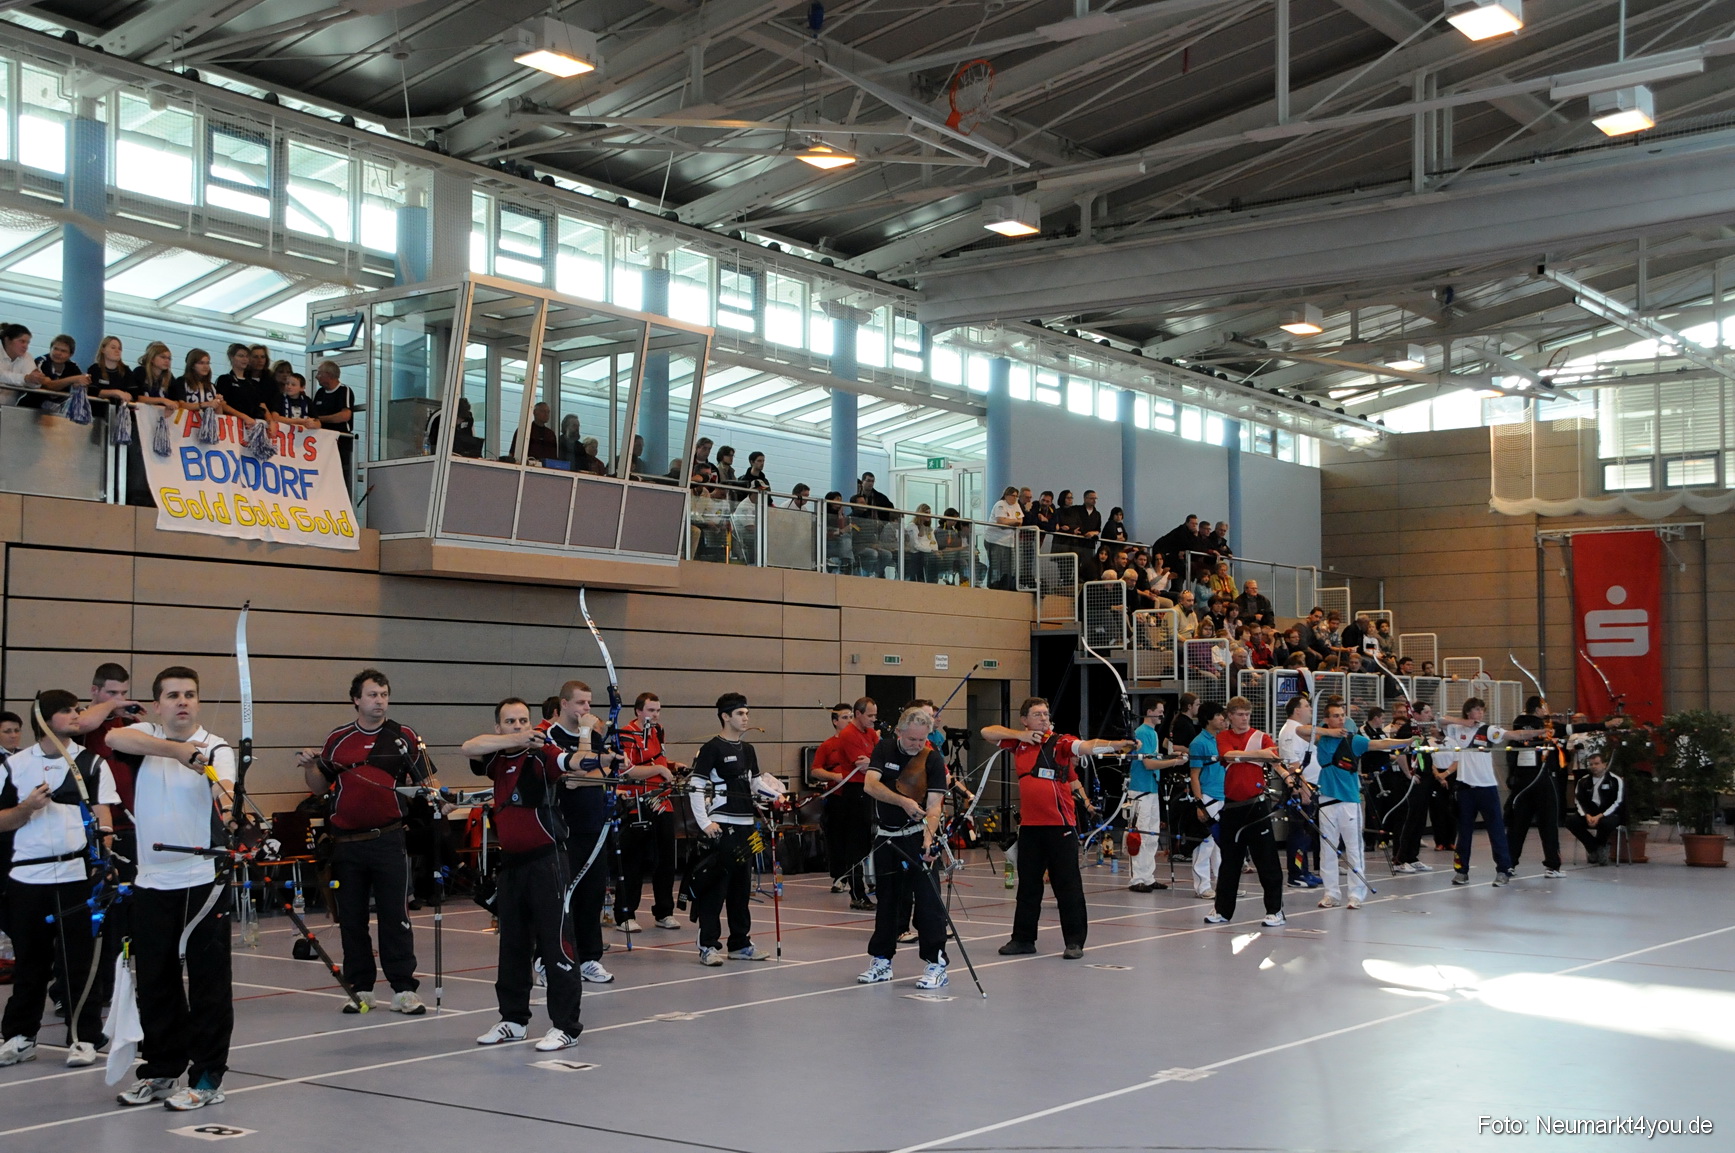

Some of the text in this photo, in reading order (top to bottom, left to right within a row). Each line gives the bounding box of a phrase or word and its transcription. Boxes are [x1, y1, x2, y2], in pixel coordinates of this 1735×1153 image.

[237, 416, 317, 462] ht's
[179, 446, 319, 501] BOXDORF
[159, 487, 355, 538] Gold Gold Gold
